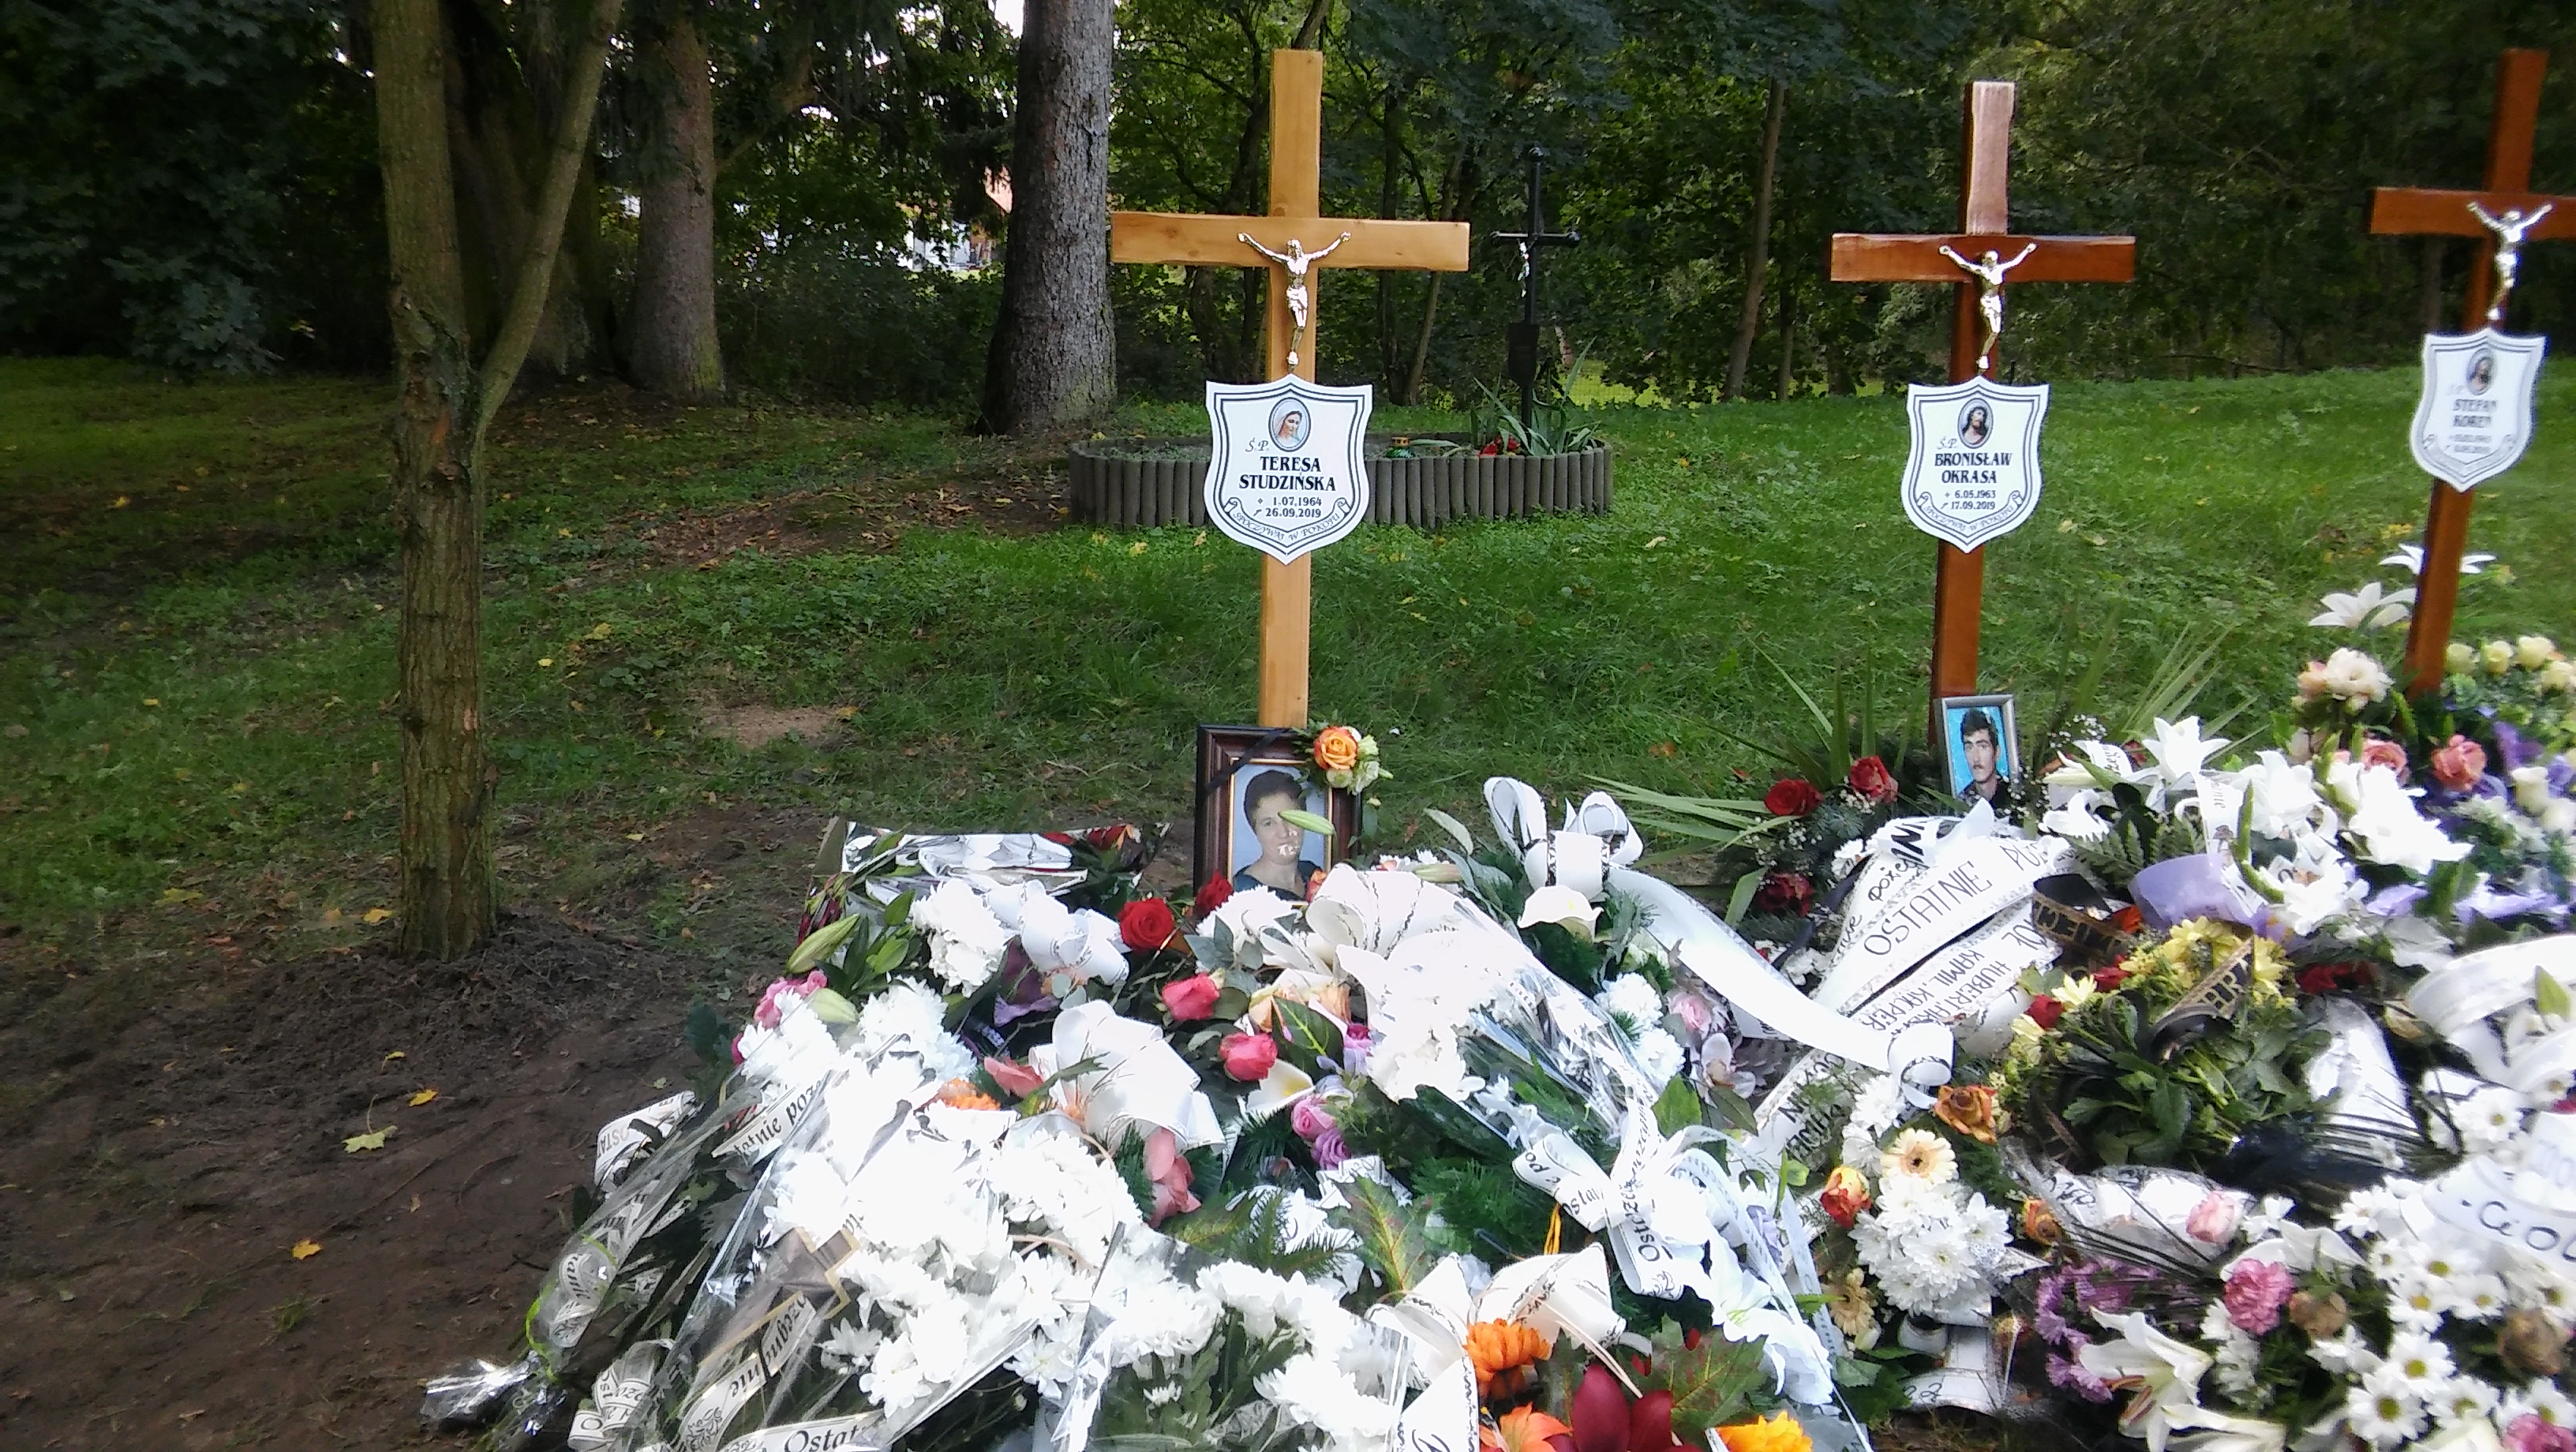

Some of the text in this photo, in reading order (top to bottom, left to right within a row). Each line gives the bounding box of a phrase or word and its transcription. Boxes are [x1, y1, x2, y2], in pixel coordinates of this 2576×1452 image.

[1260, 456, 1321, 472] TERESA
[1934, 452, 2012, 466] BRONISŁAW
[1238, 472, 1337, 492] STUDZIŃSKA
[1941, 470, 1998, 484] OKRASA
[1272, 496, 1322, 507] 1.07.1964
[1950, 501, 1996, 510] 17.09.2019
[1265, 507, 1322, 518] 26.09.2019
[1288, 532, 1299, 541] W
[1301, 513, 1341, 537] POKOJU
[1863, 861, 1993, 956] OSTATNIE
